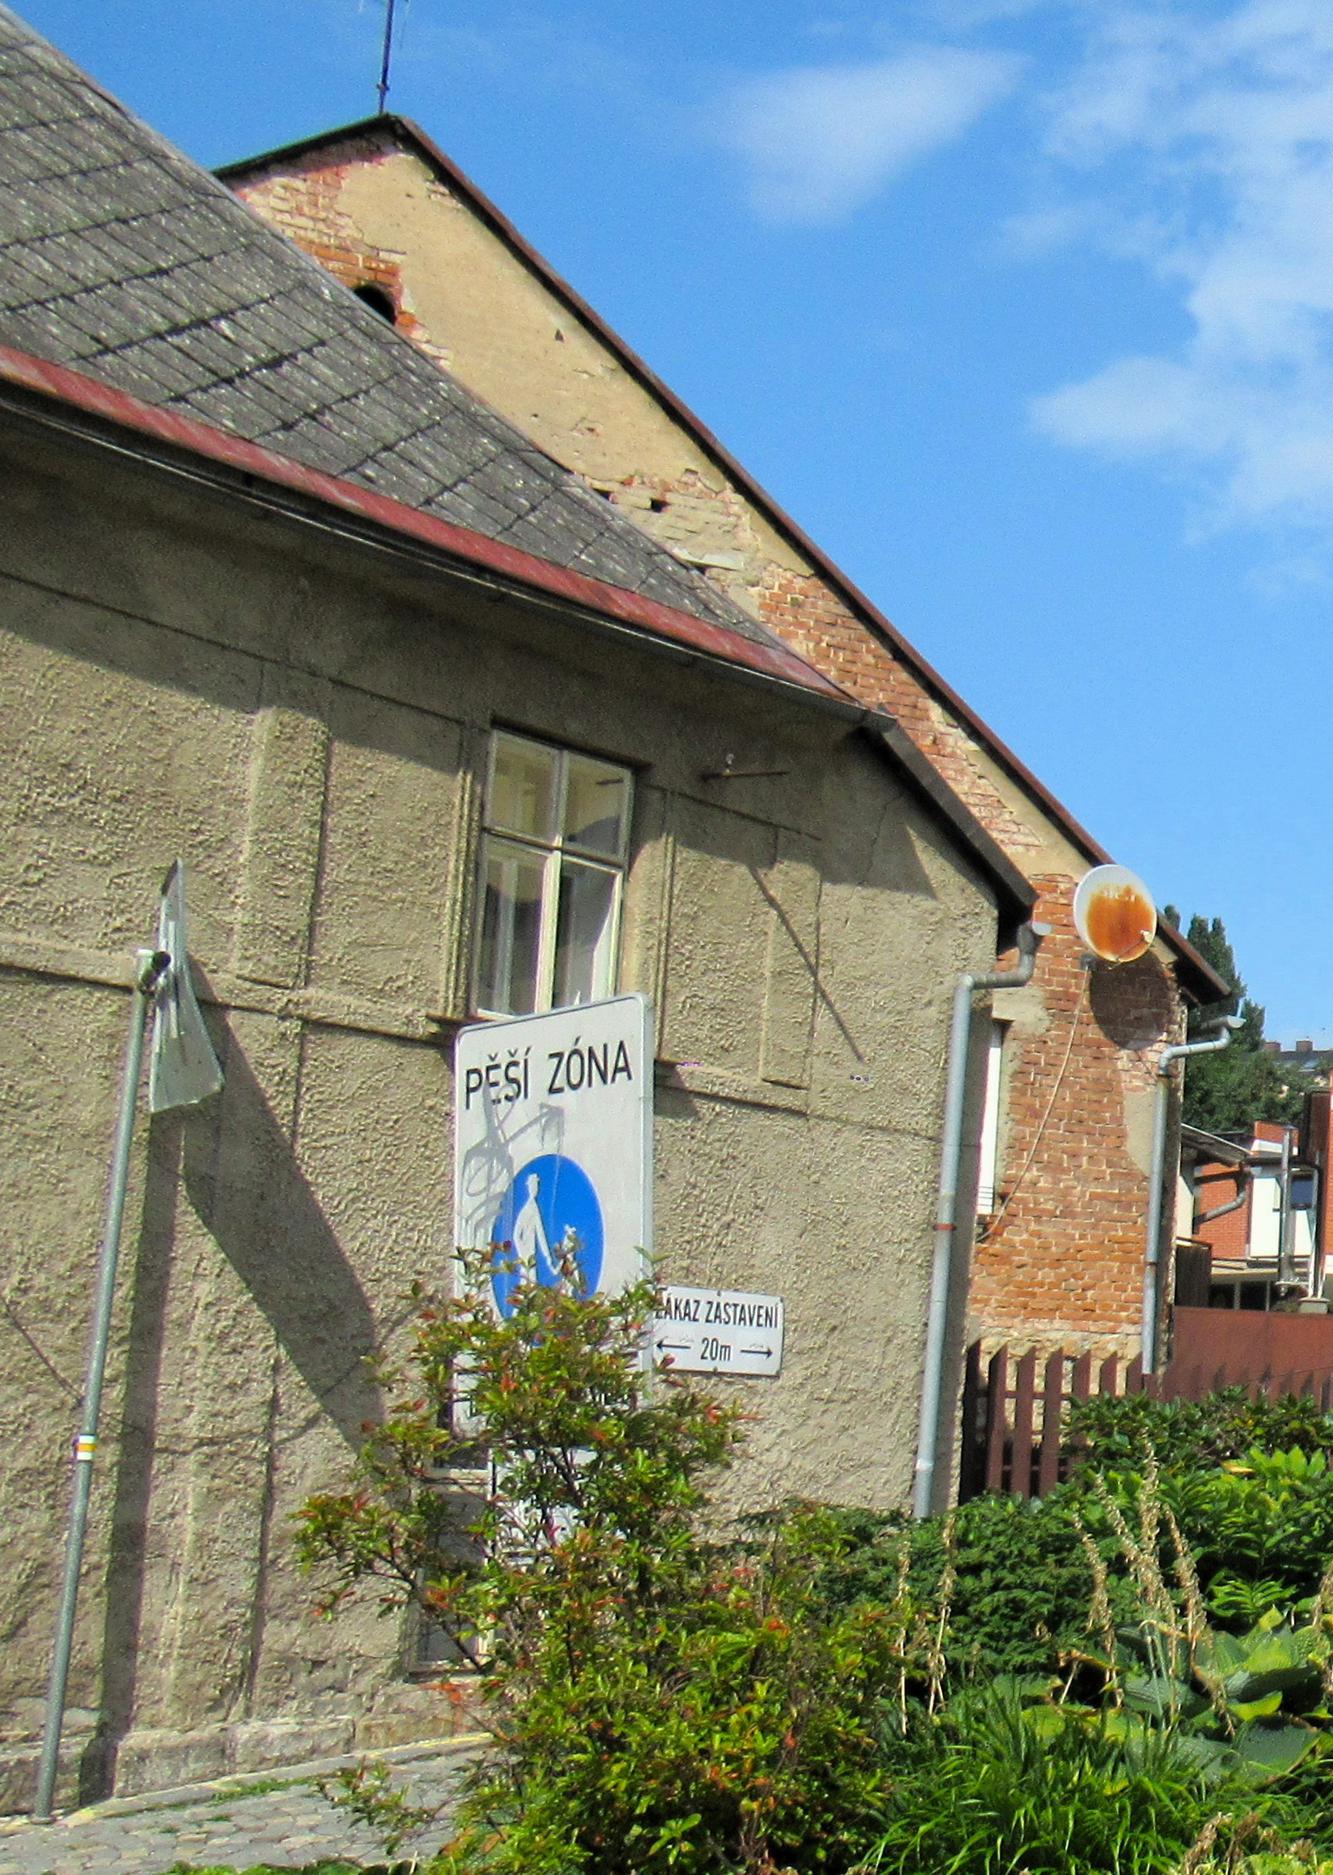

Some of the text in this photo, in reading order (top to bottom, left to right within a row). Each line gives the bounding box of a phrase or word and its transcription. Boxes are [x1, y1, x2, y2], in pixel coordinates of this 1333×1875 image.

[465, 1035, 632, 1110] PĚŠÍ ZÓNA
[705, 1300, 779, 1329] ZASTAVENÍ
[700, 1336, 732, 1361] 20m
